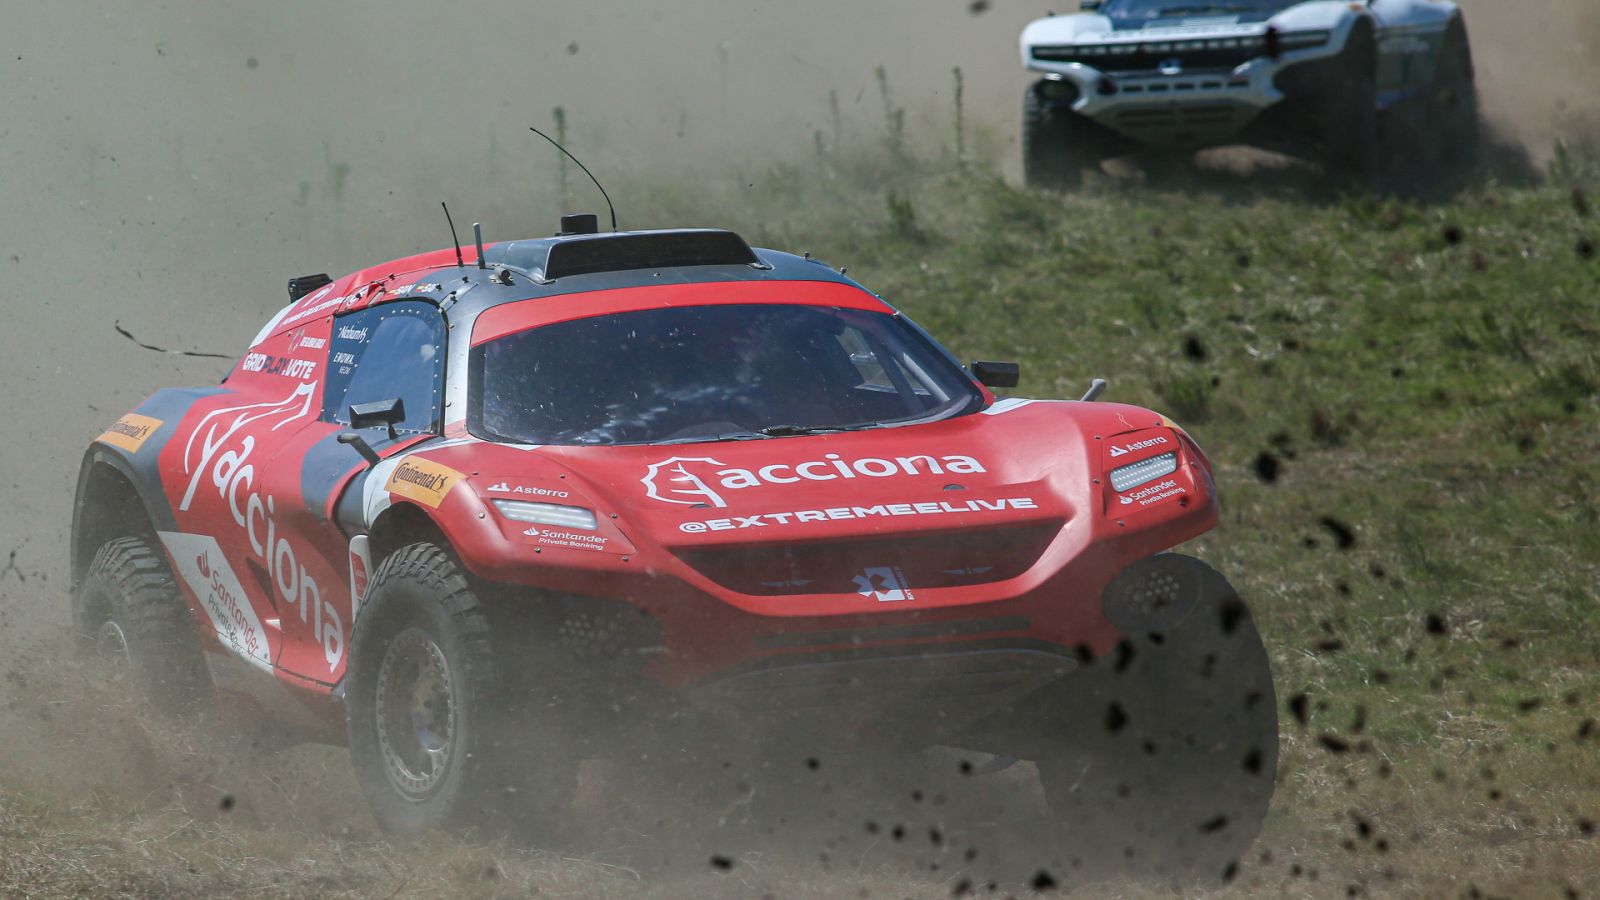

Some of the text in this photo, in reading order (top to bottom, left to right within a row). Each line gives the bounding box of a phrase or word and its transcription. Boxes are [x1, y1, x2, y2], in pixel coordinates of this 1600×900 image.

[1126, 436, 1168, 452] Asterra
[393, 462, 442, 491] Continental
[716, 453, 987, 489] acciona
[513, 485, 569, 499] Asterra
[1130, 480, 1177, 501] Santander
[679, 497, 1038, 533] @EXTREMEELIVE
[538, 537, 604, 551] Private Banking
[541, 529, 608, 544] Santander
[212, 435, 344, 673] acciona
